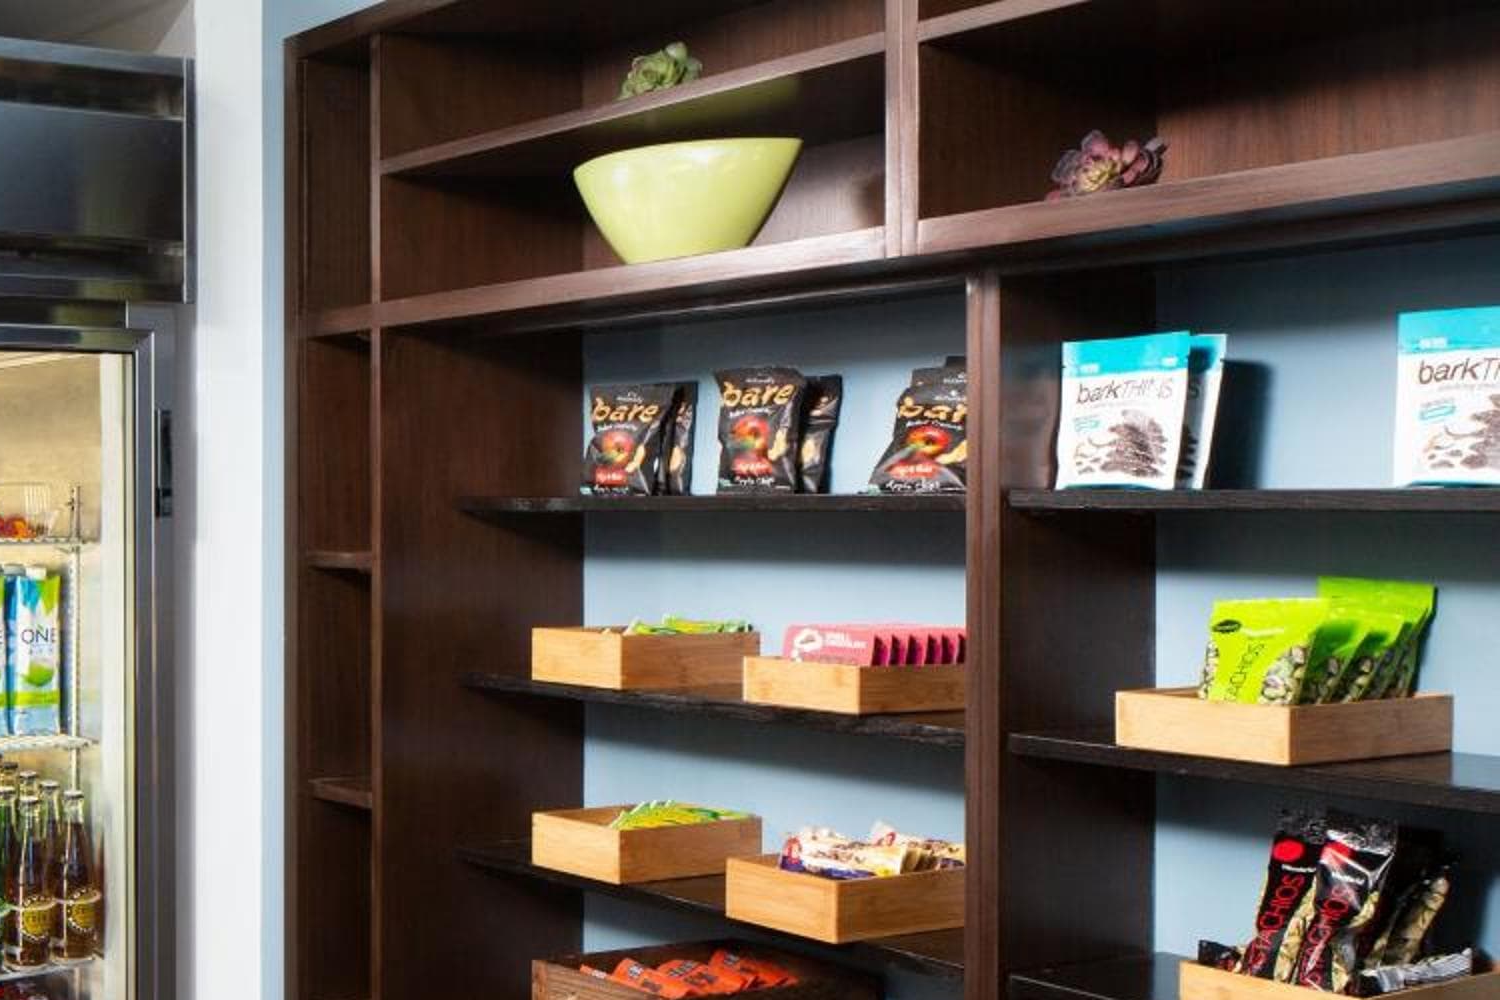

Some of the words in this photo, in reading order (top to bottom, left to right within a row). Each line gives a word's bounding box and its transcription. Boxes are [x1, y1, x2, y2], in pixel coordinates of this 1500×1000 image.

[722, 381, 795, 407] bare
[592, 398, 659, 423] bare
[22, 626, 56, 646] ONE
